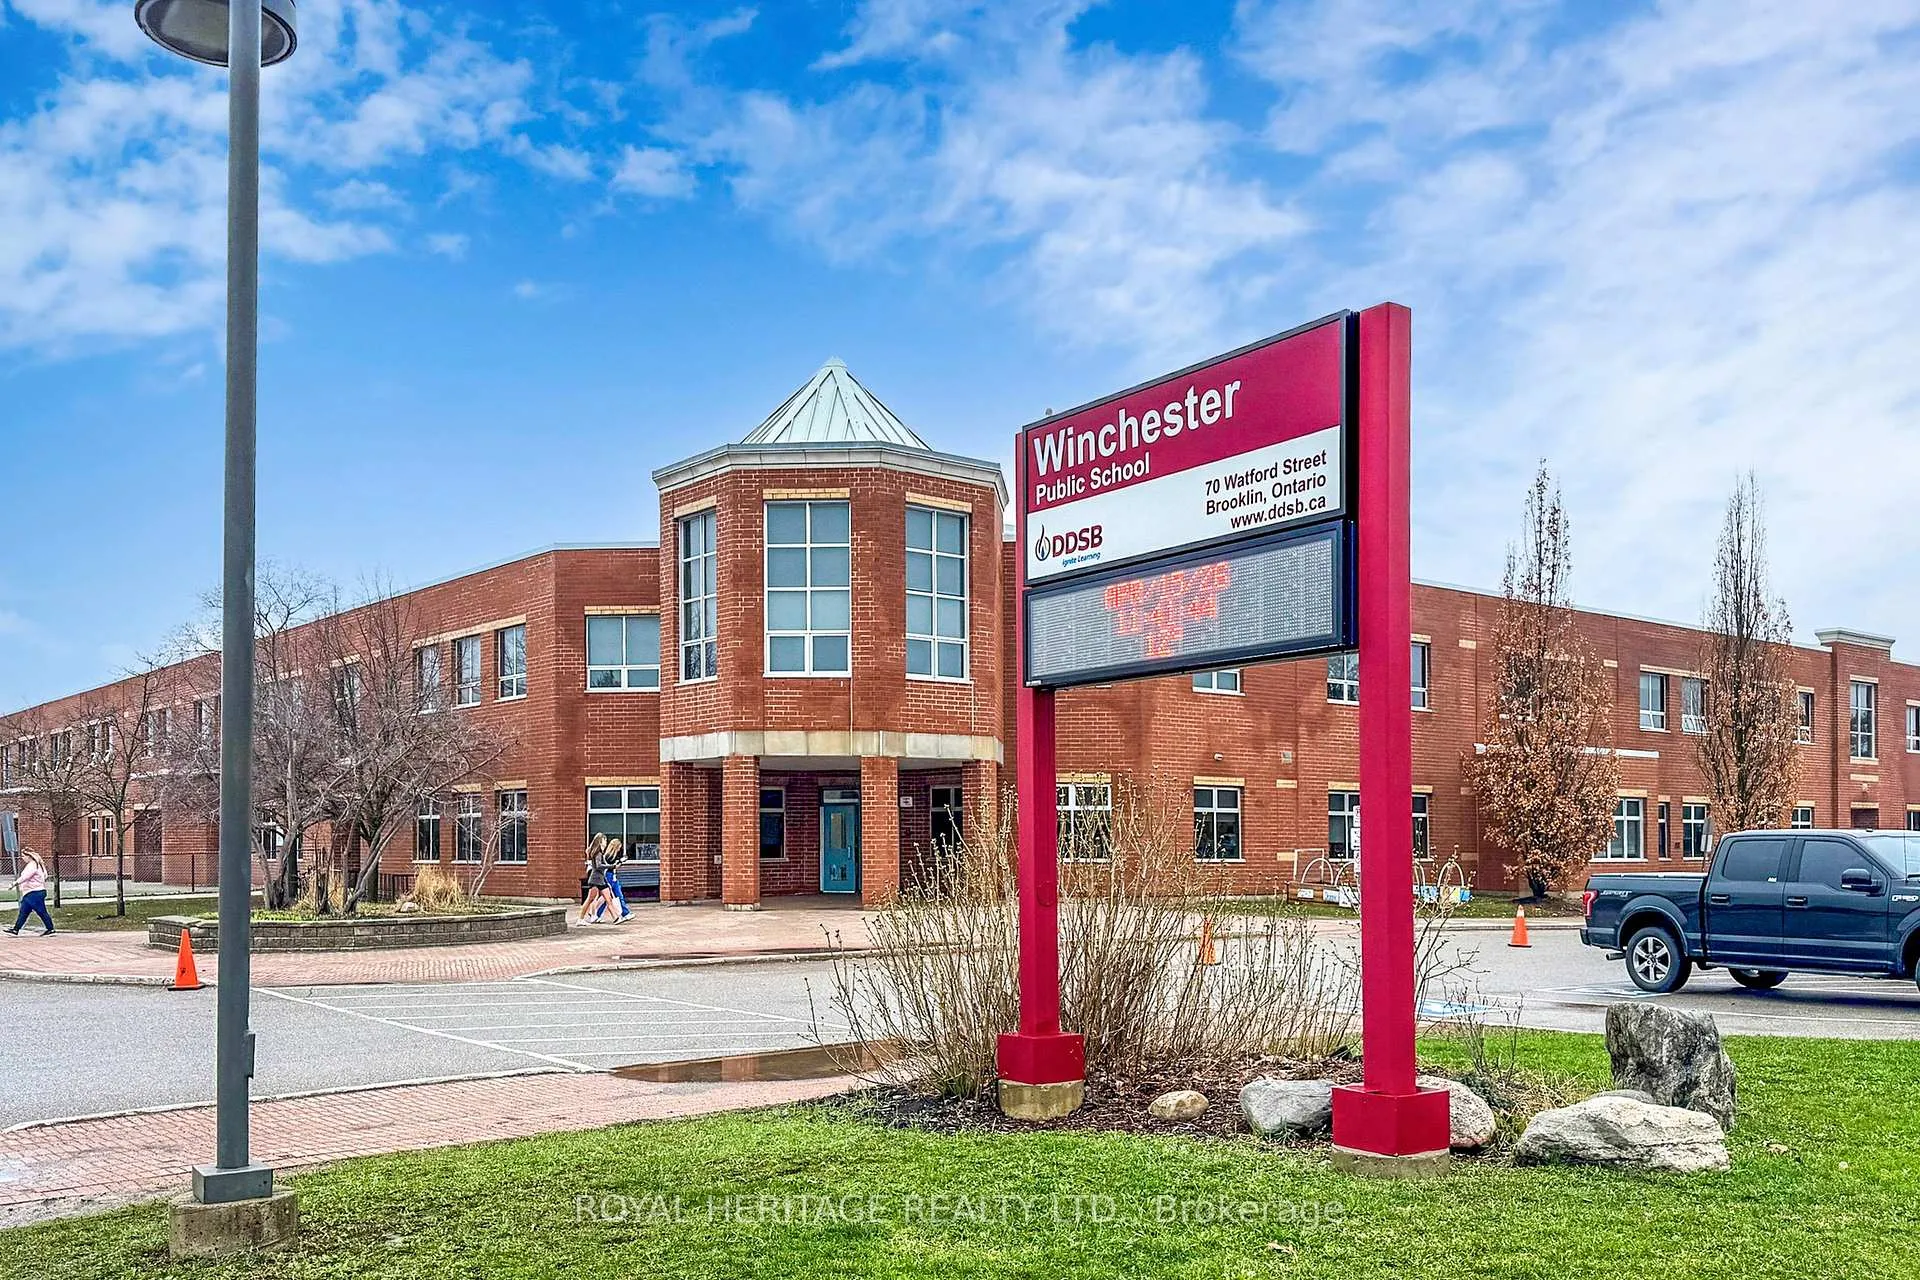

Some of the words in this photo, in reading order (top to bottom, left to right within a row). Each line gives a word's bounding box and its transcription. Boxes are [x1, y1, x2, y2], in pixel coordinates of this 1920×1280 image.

[1033, 380, 1241, 477] Winchester
[1036, 475, 1086, 505] Public
[1090, 452, 1150, 490] School
[1205, 478, 1220, 496] 70
[1224, 462, 1278, 491] Watford
[1283, 449, 1327, 475] Street
[1206, 489, 1267, 515] Brooklin,
[1272, 473, 1327, 498] Ontario
[1231, 496, 1326, 529] www.ddsb.ca
[1052, 525, 1103, 557] DDSB
[1078, 552, 1101, 563] Learning
